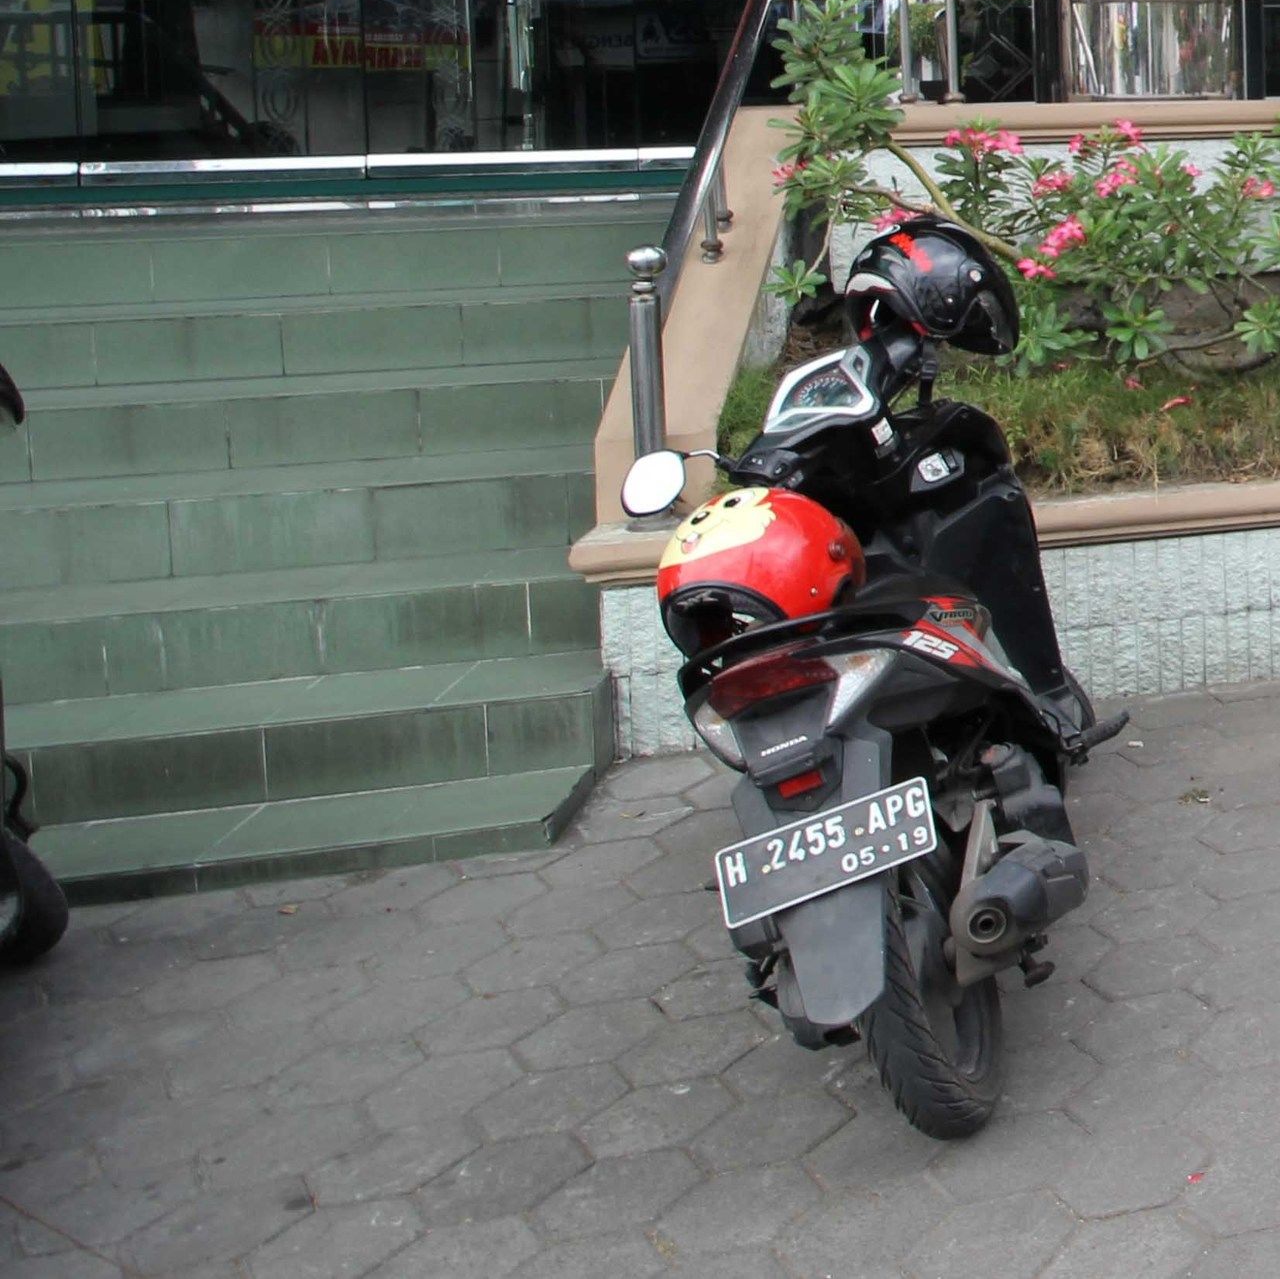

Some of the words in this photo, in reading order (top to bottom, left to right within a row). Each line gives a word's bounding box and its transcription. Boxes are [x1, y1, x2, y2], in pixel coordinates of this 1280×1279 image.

[903, 630, 959, 660] 125
[760, 735, 808, 757] HONDA
[725, 852, 748, 887] H
[766, 815, 846, 870] 2455
[868, 787, 926, 834] APG
